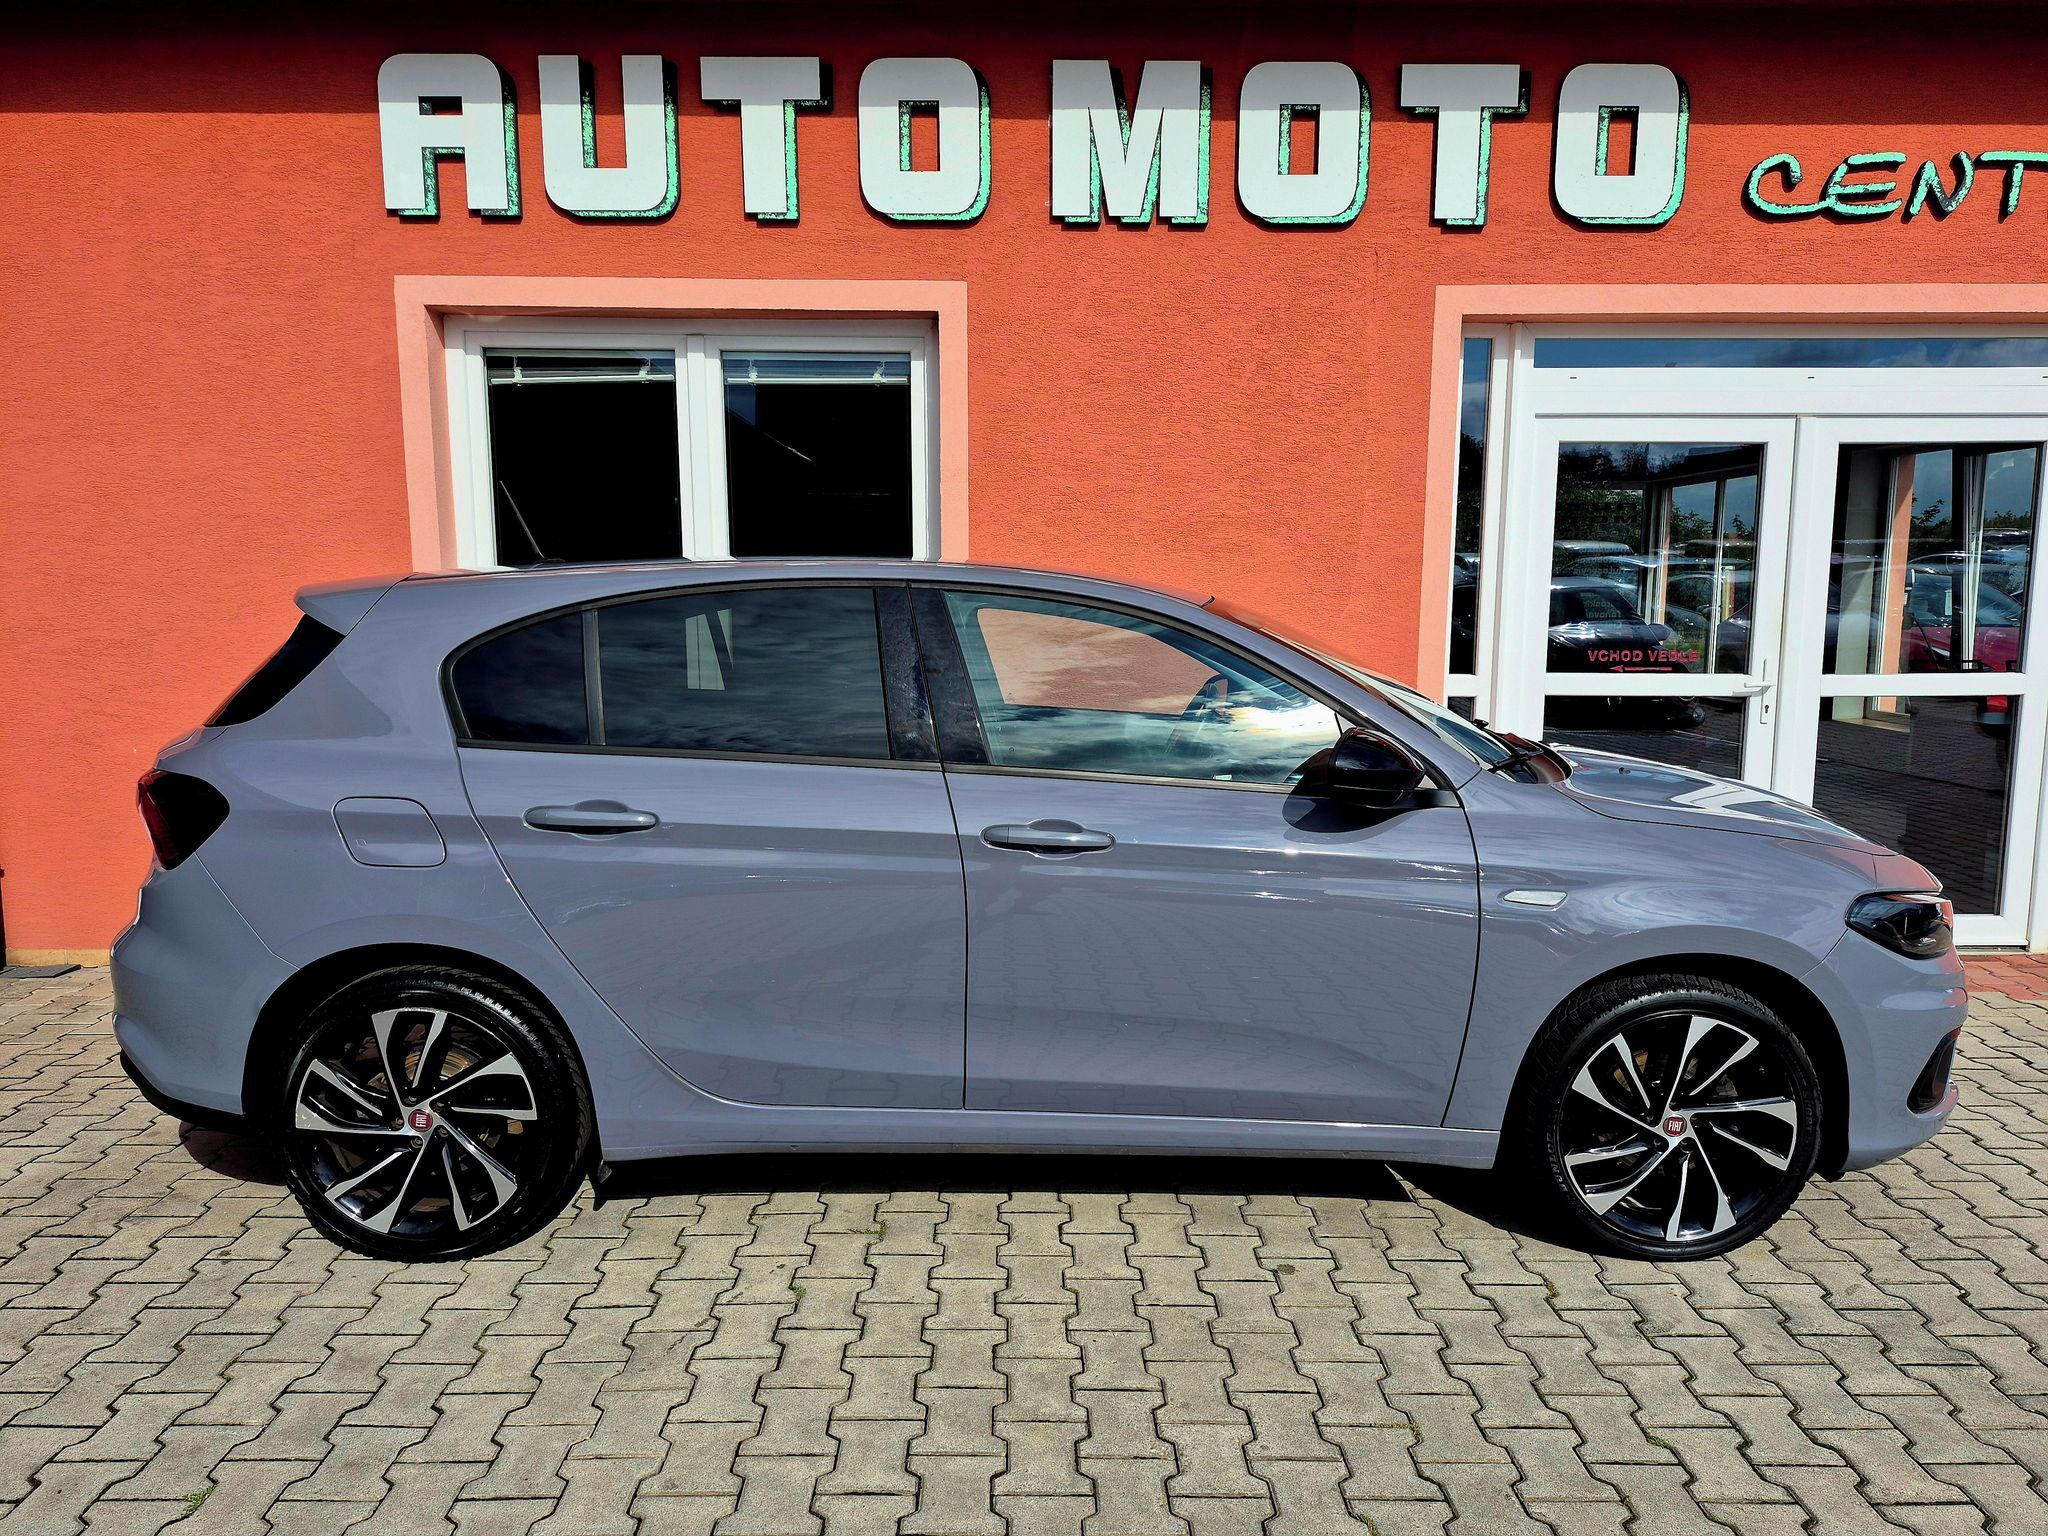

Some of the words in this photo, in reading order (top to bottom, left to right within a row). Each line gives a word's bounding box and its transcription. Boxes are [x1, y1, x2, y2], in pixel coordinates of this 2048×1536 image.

[377, 53, 990, 222] AUTO
[1052, 59, 1690, 225] MOTO
[1747, 151, 2047, 222] CENT
[1587, 650, 1643, 662] VCHOD
[1648, 650, 1699, 662] VEDLE
[415, 1113, 427, 1127] FIAT
[1668, 1120, 1683, 1132] FIAT
